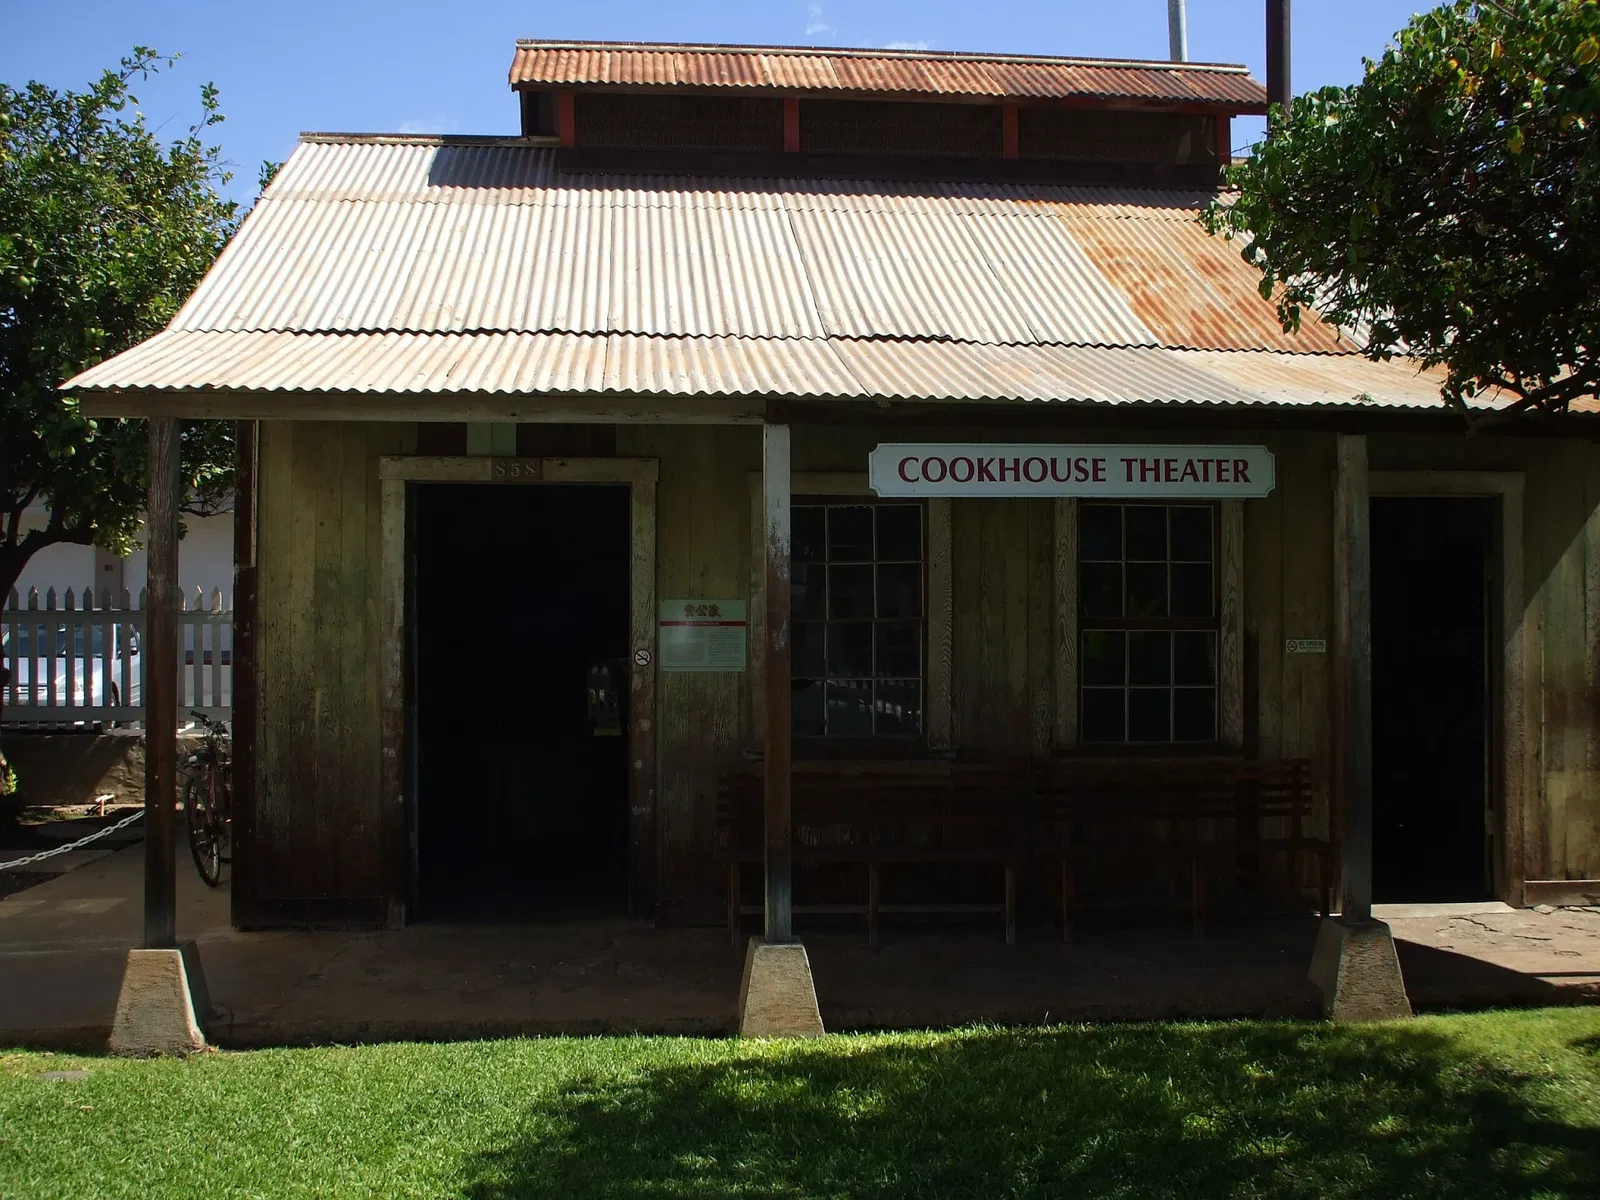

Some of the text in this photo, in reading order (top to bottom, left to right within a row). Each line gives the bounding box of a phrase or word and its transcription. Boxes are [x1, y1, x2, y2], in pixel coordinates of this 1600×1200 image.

[496, 459, 536, 477] 858
[898, 457, 1251, 483] COOKHOUSE THEATER
